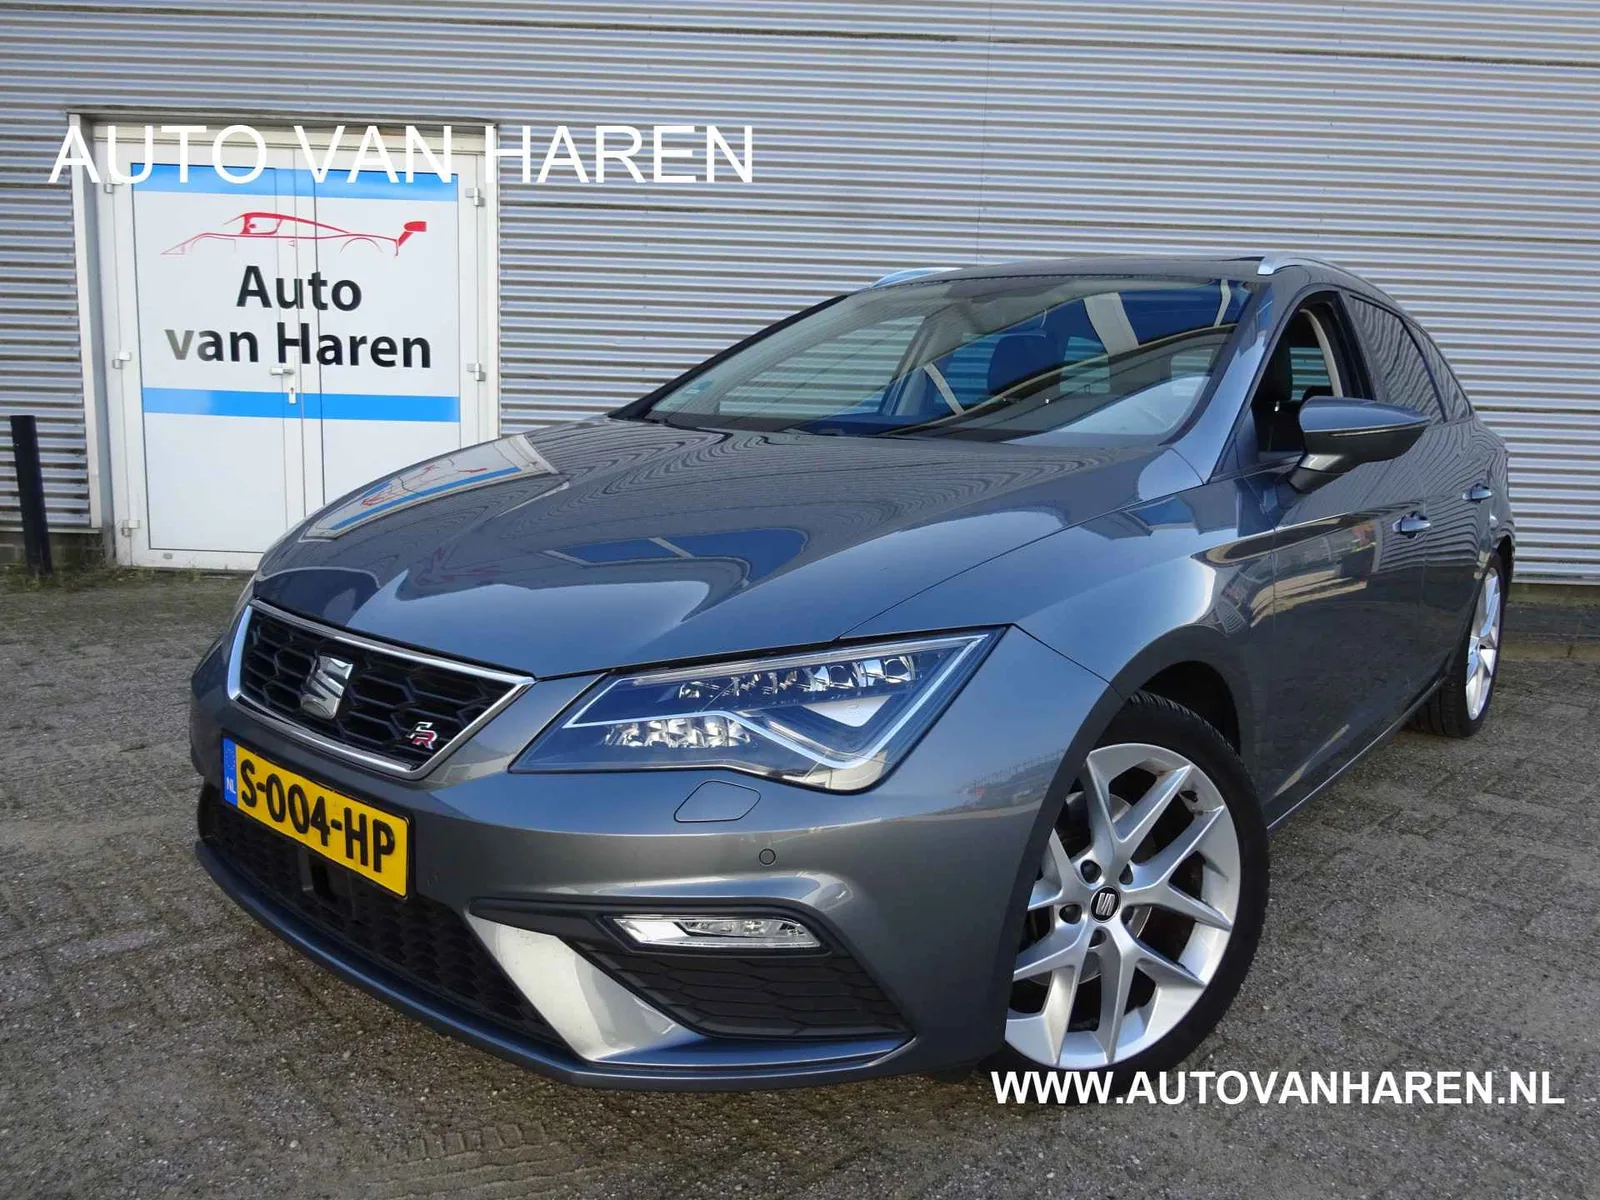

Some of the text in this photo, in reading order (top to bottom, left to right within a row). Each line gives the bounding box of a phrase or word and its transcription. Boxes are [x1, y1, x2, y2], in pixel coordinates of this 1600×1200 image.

[236, 265, 362, 312] Auto
[164, 321, 431, 369] van Haren
[240, 758, 396, 873] S-004-HP
